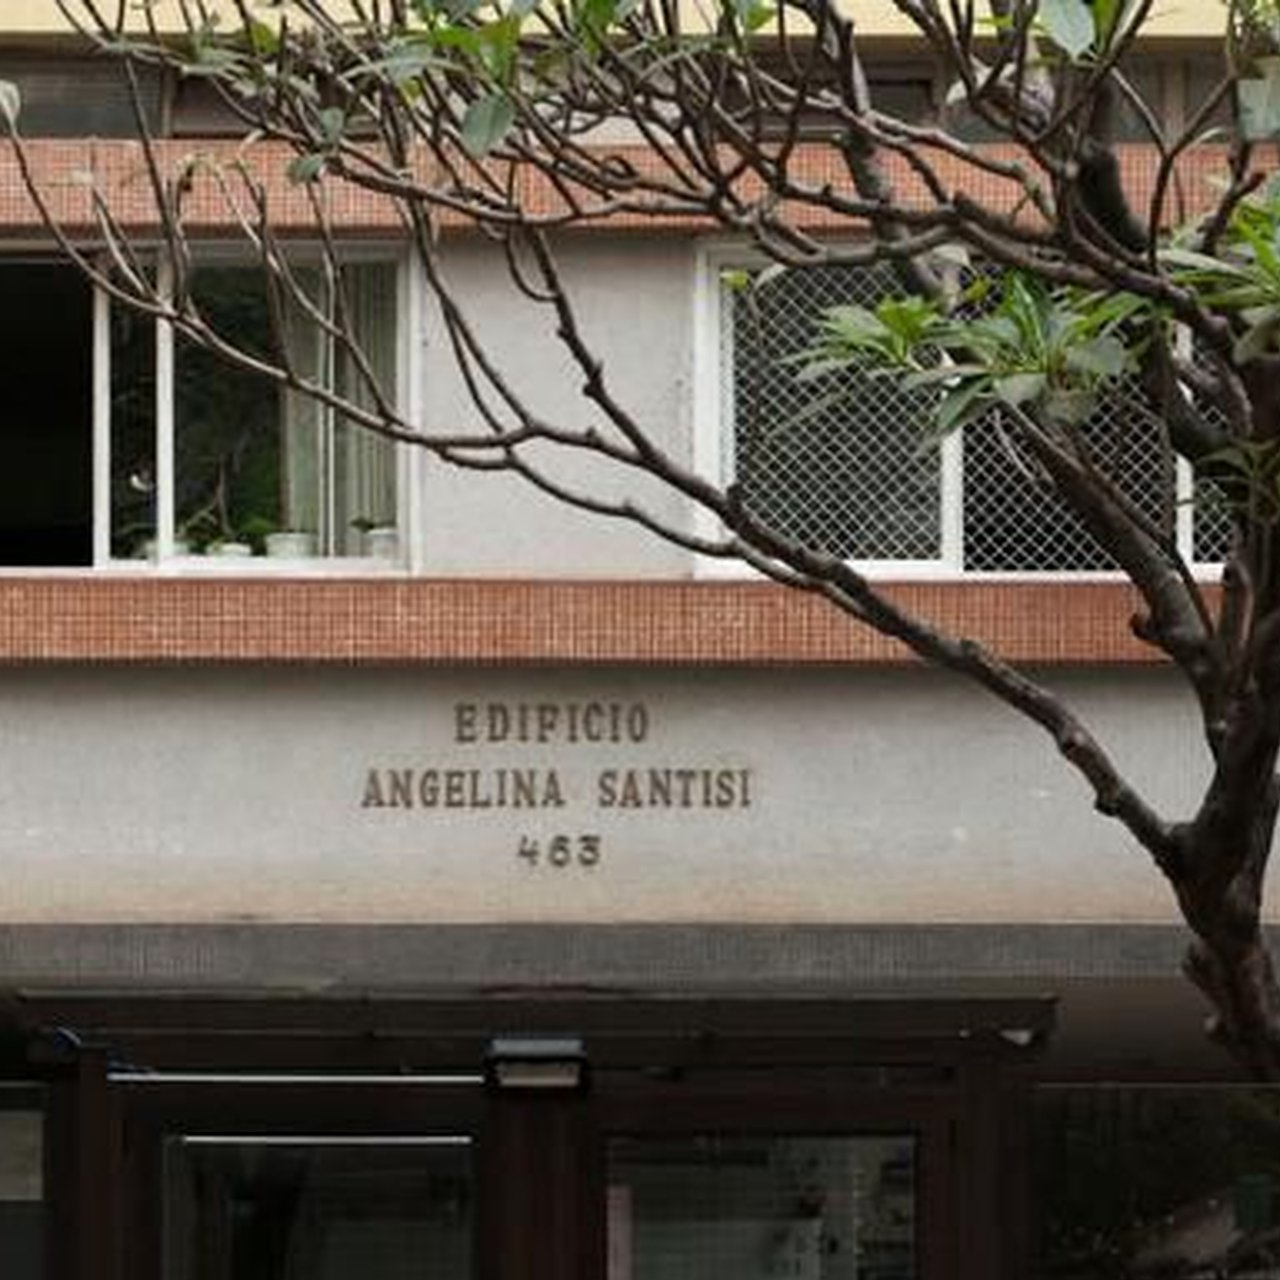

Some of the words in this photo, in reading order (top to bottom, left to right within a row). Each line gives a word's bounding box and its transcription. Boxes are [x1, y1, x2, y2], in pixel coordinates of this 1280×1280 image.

[454, 702, 650, 743] EDIFICIO
[361, 769, 566, 809] ANGELINA
[598, 768, 753, 809] SANTISI
[518, 836, 602, 867] 463
